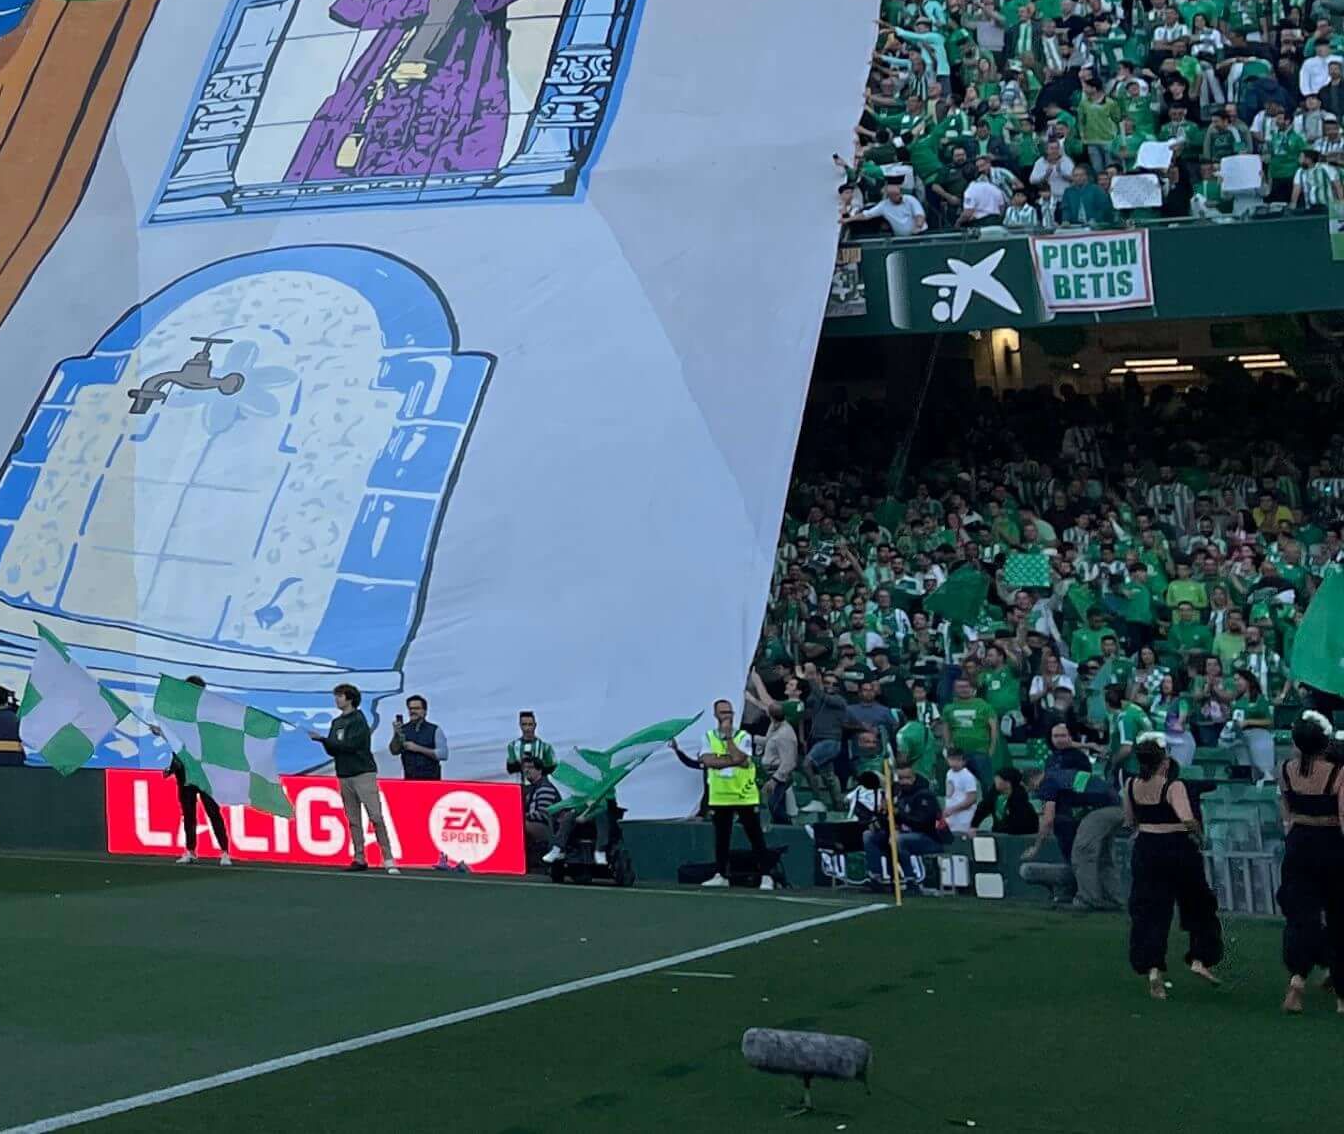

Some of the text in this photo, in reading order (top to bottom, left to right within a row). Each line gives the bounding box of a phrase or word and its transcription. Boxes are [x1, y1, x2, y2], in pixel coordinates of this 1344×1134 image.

[1041, 238, 1138, 269] PICCHI
[1053, 269, 1134, 300] BETIS
[442, 807, 487, 833] EA
[440, 831, 490, 845] SPORTS
